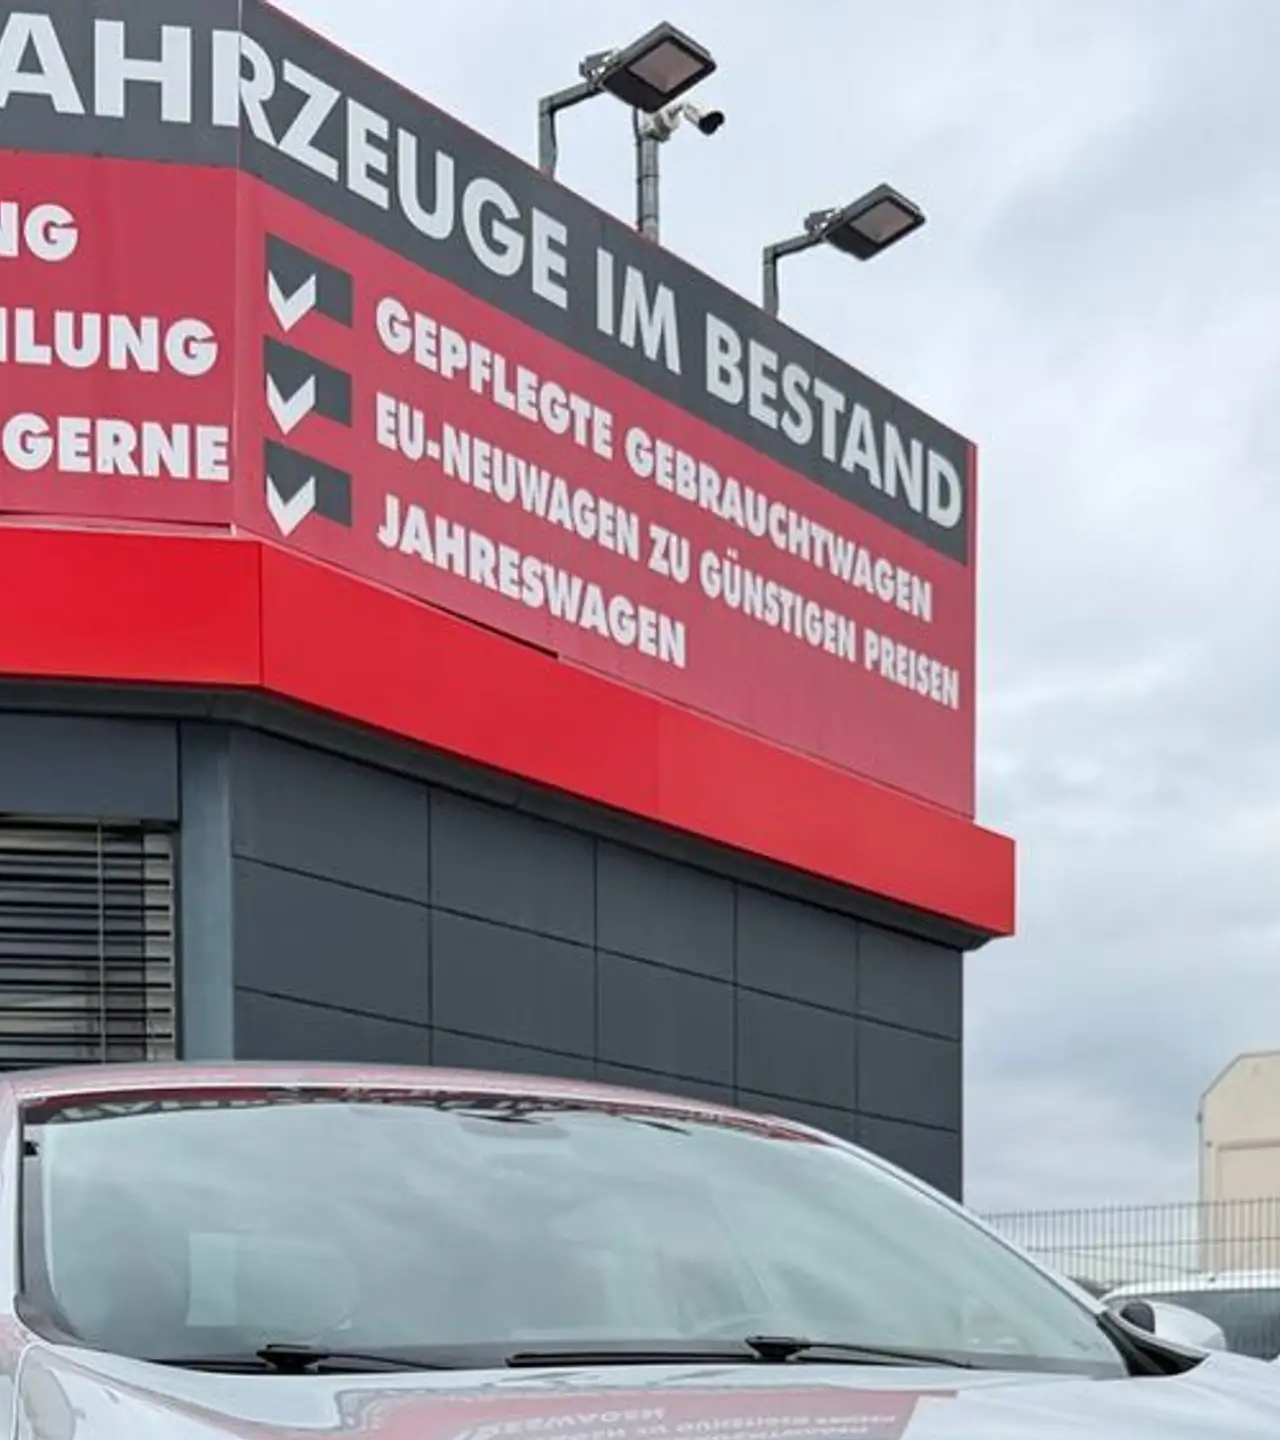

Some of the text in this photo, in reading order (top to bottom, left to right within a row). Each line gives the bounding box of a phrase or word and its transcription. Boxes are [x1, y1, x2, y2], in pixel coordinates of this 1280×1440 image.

[3, 412, 229, 481] GERNE
[375, 297, 932, 623] GEPFLEGTE GEBRAUCHTWAGEN
[596, 249, 681, 375] IM
[705, 312, 962, 530] BESTAND
[375, 393, 959, 711] EU-NEUWAGEN ZU GÜNSTIGEN PREISEN
[377, 494, 687, 667] JAHRESWAGEN
